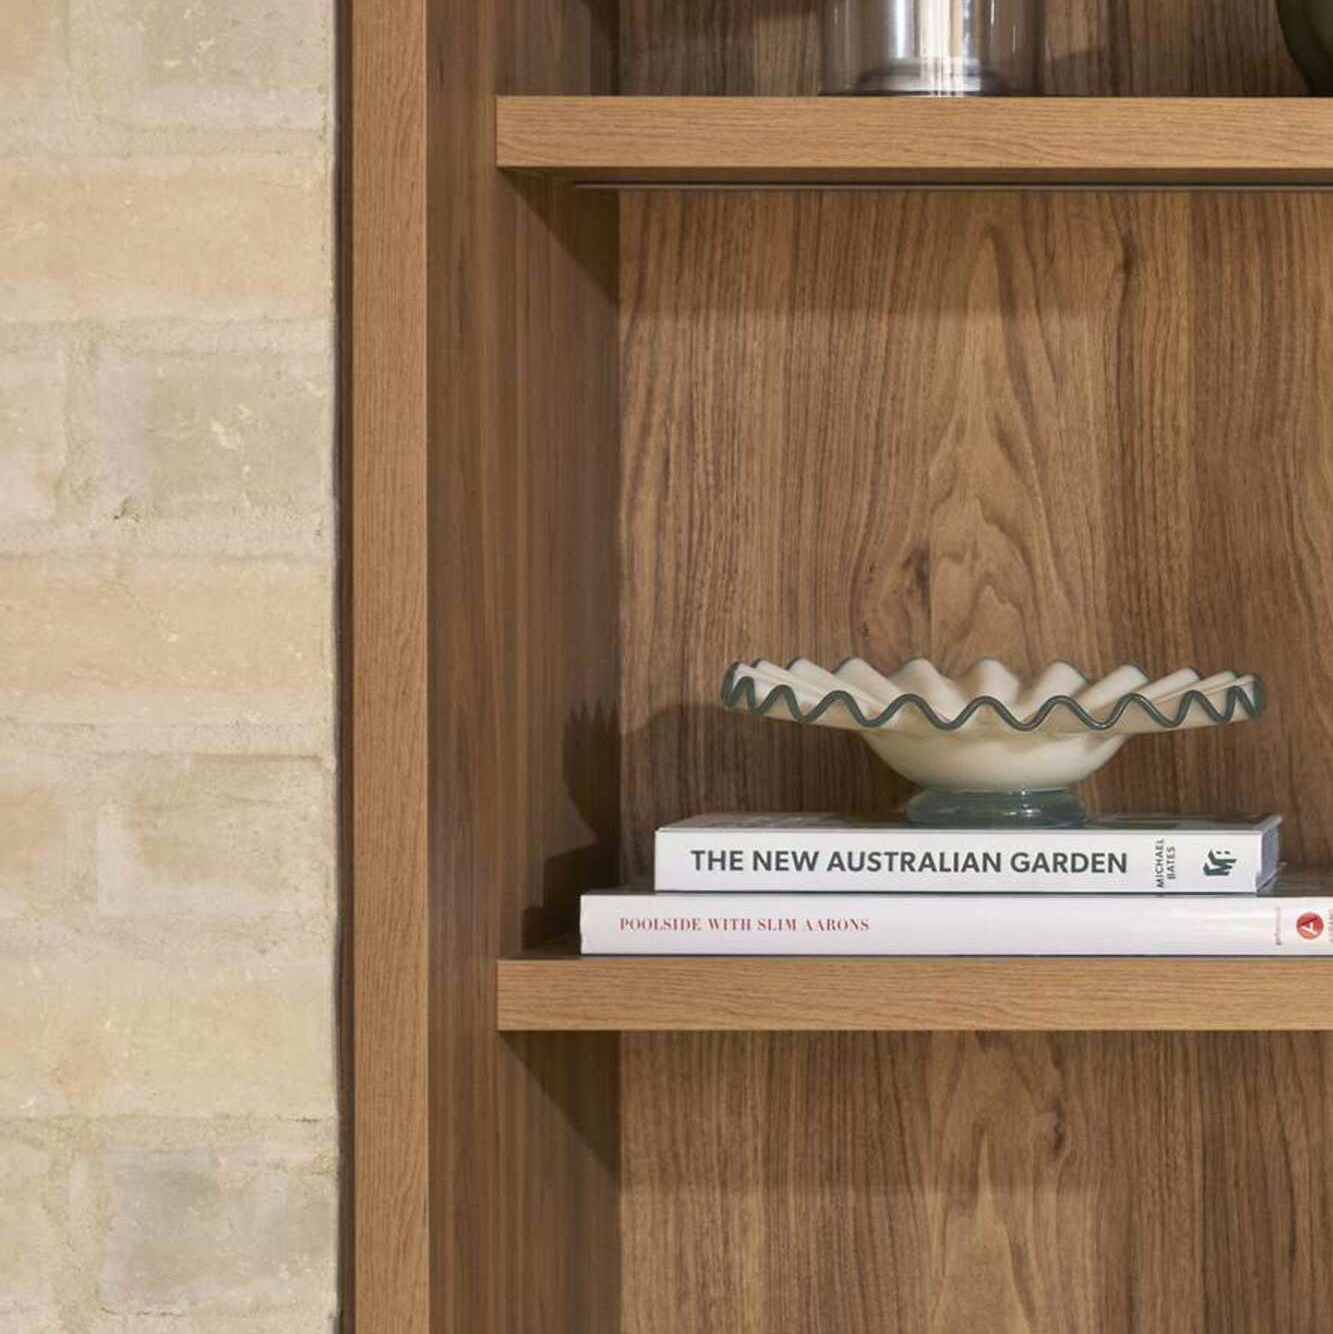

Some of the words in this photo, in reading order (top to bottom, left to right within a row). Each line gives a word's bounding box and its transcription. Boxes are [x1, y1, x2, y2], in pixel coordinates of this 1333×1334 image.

[691, 850, 743, 871] THE
[752, 850, 820, 872] NEW
[826, 851, 1001, 873] AUSTRALIAN
[1010, 852, 1127, 874] GARDEN
[1155, 839, 1164, 888] MICHAEL
[1167, 846, 1176, 879] BATES
[620, 918, 701, 931] POOLSIDE
[708, 918, 751, 931] WITH
[757, 918, 797, 932] SLIM
[804, 918, 870, 932] AARONS
